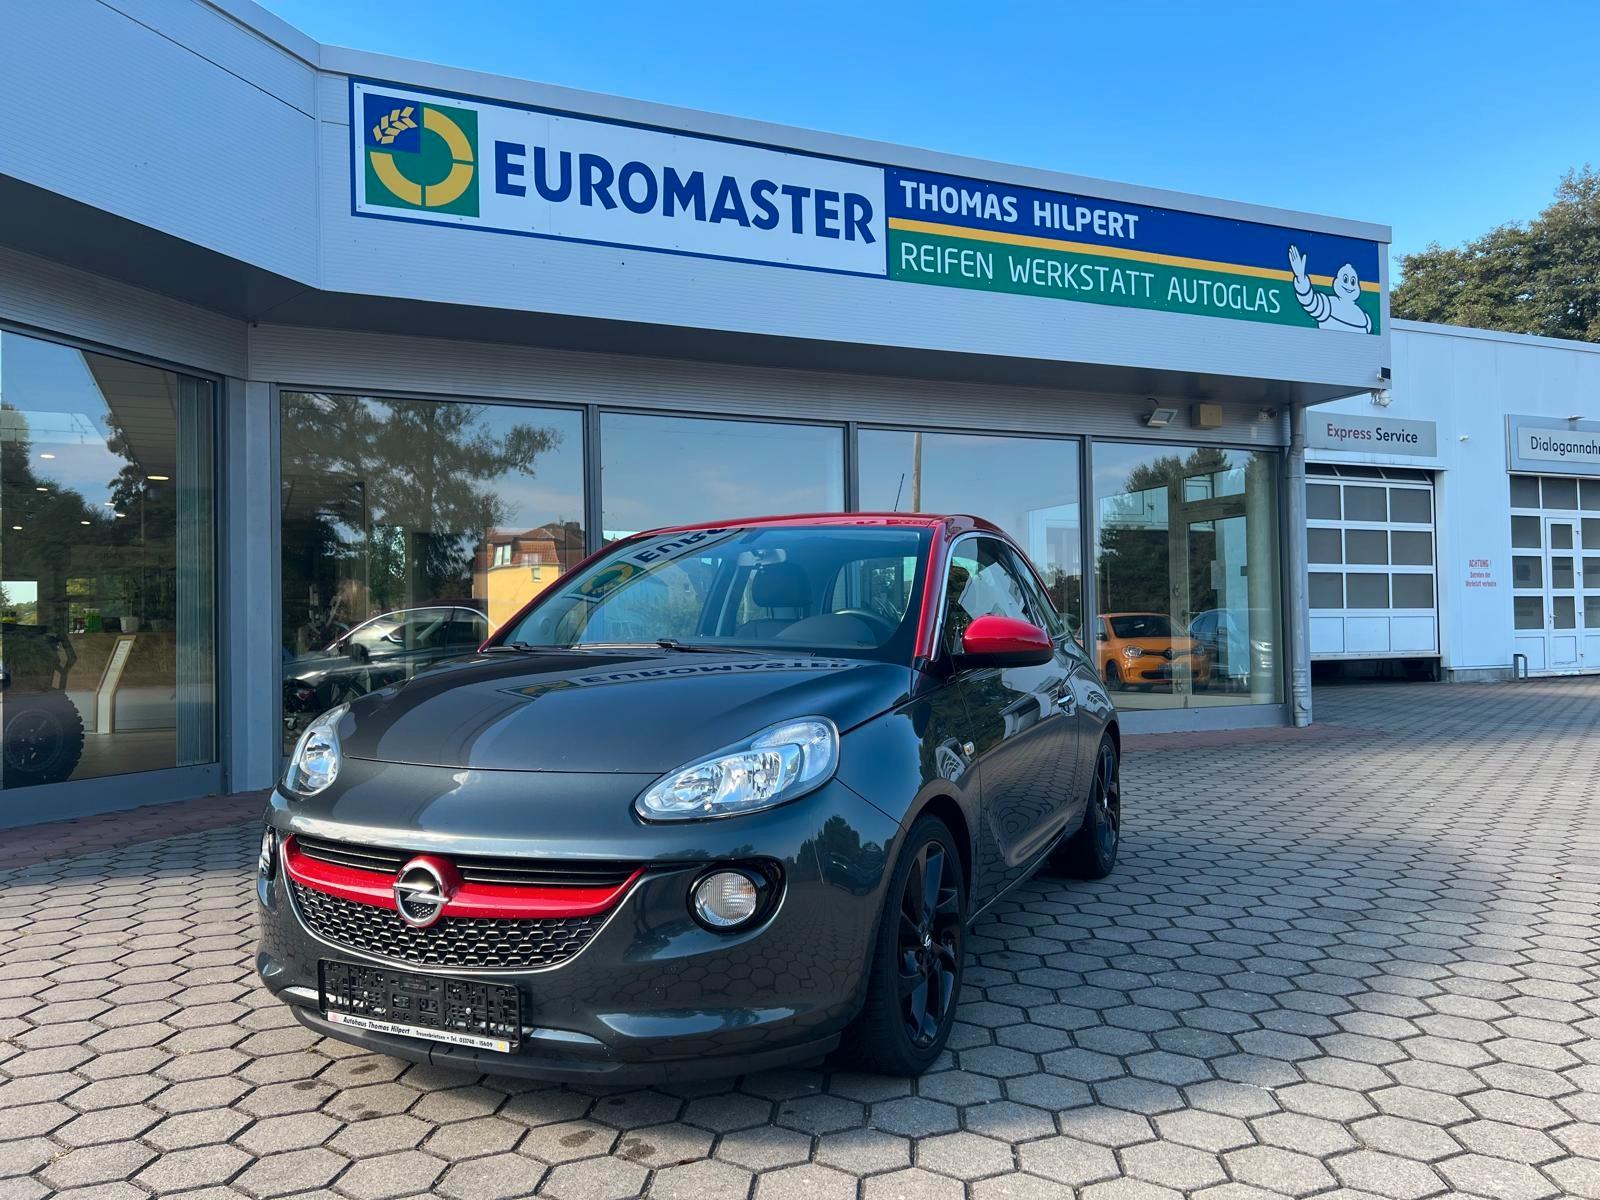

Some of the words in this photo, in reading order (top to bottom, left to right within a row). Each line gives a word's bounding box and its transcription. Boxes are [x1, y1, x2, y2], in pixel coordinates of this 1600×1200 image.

[494, 140, 877, 244] EUROMASTER
[899, 180, 1018, 223] THOMAS
[1034, 201, 1139, 240] HILPERT
[900, 242, 993, 280] REIFEN
[1008, 255, 1154, 298] WERKSTATT
[1167, 276, 1281, 314] AUTOGLAS
[1326, 423, 1372, 441] Express
[1375, 427, 1418, 443] Service
[1530, 435, 1600, 456] Dialogannah
[343, 1016, 367, 1028] Autohaus
[368, 1021, 390, 1031] Thomas
[390, 1025, 410, 1035] Hilpert
